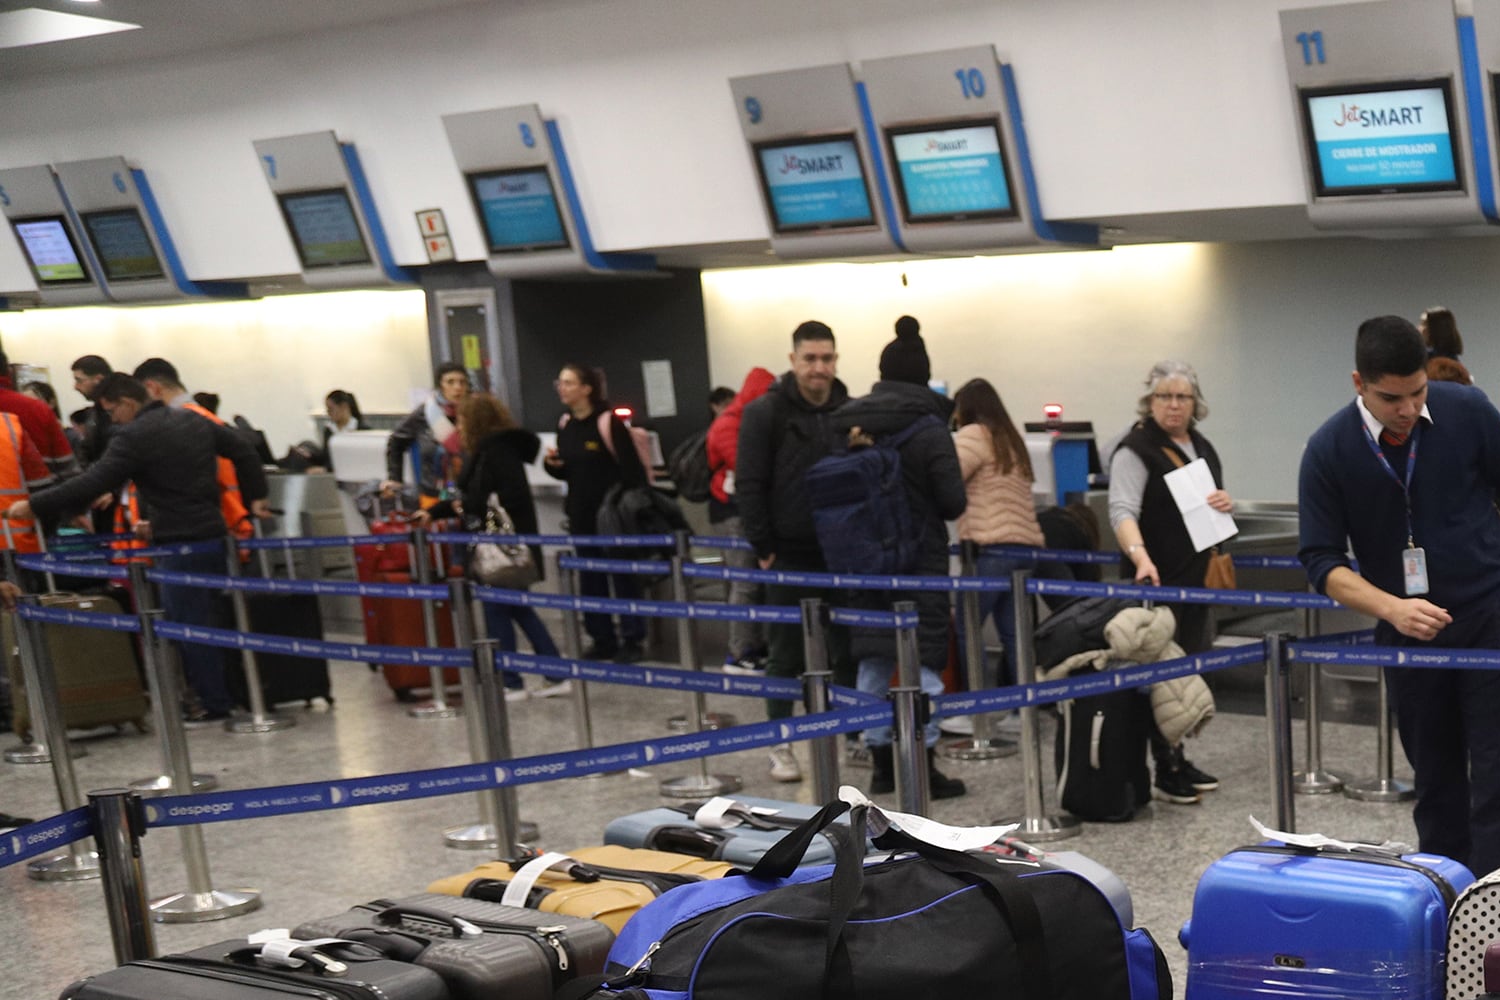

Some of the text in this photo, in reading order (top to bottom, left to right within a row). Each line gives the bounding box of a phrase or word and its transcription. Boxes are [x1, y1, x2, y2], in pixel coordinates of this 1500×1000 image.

[1296, 31, 1326, 65] 11
[955, 67, 986, 99] 10
[744, 96, 762, 124] 9
[1334, 102, 1423, 127] JetSMART
[514, 761, 567, 777] despegar
[351, 783, 410, 798] despegar
[169, 801, 234, 817] despegar
[27, 824, 67, 845] despegar
